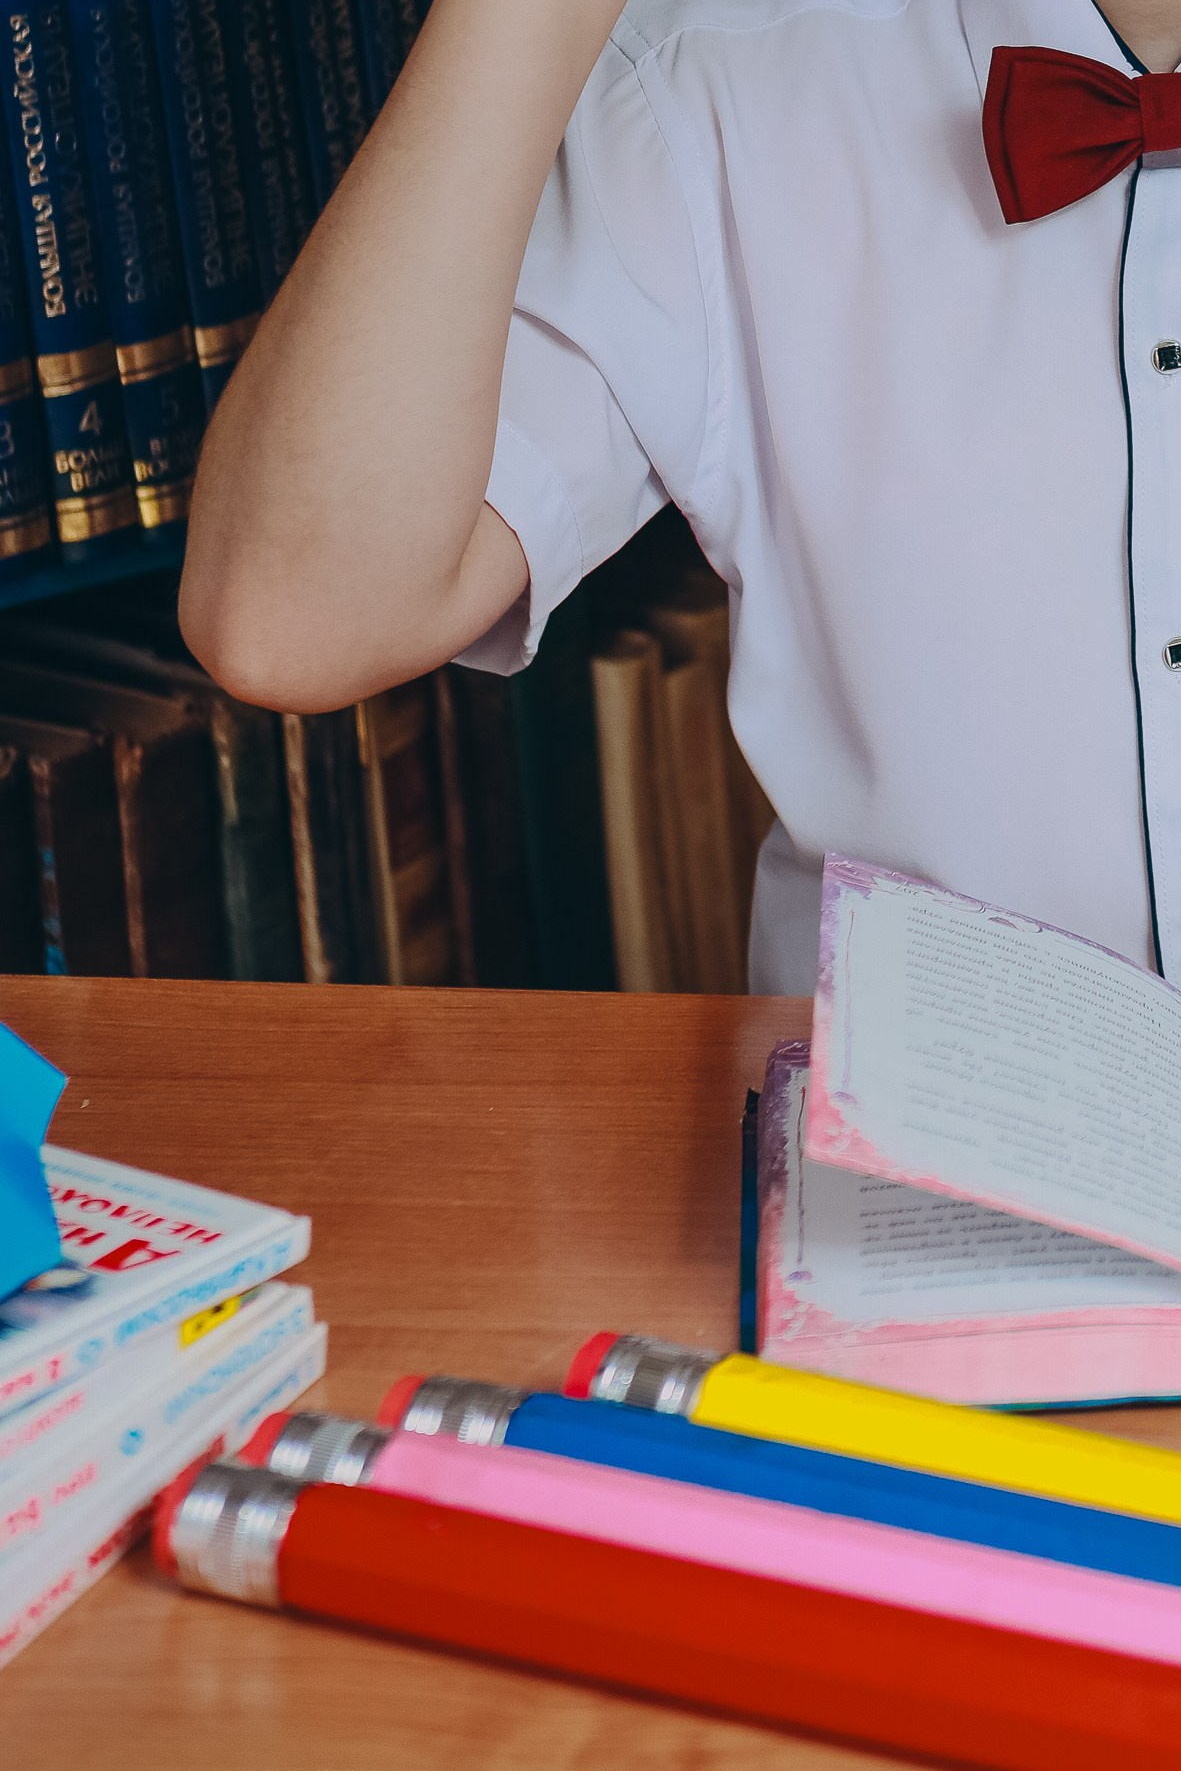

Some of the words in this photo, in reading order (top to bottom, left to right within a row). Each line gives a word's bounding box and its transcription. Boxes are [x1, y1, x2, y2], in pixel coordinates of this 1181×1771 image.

[10, 14, 48, 186] РОССИЙСКАЯ
[90, 9, 126, 173] РОССИЙСКАЯ
[43, 5, 97, 307] ЭНЦИКЛОПЕДИЯ
[32, 194, 65, 317] БОЛЬШАЯ
[113, 183, 144, 303] БОЛЬШАЯ
[78, 400, 103, 436] 4
[895, 884, 921, 898] 207
[87, 1237, 183, 1274] А
